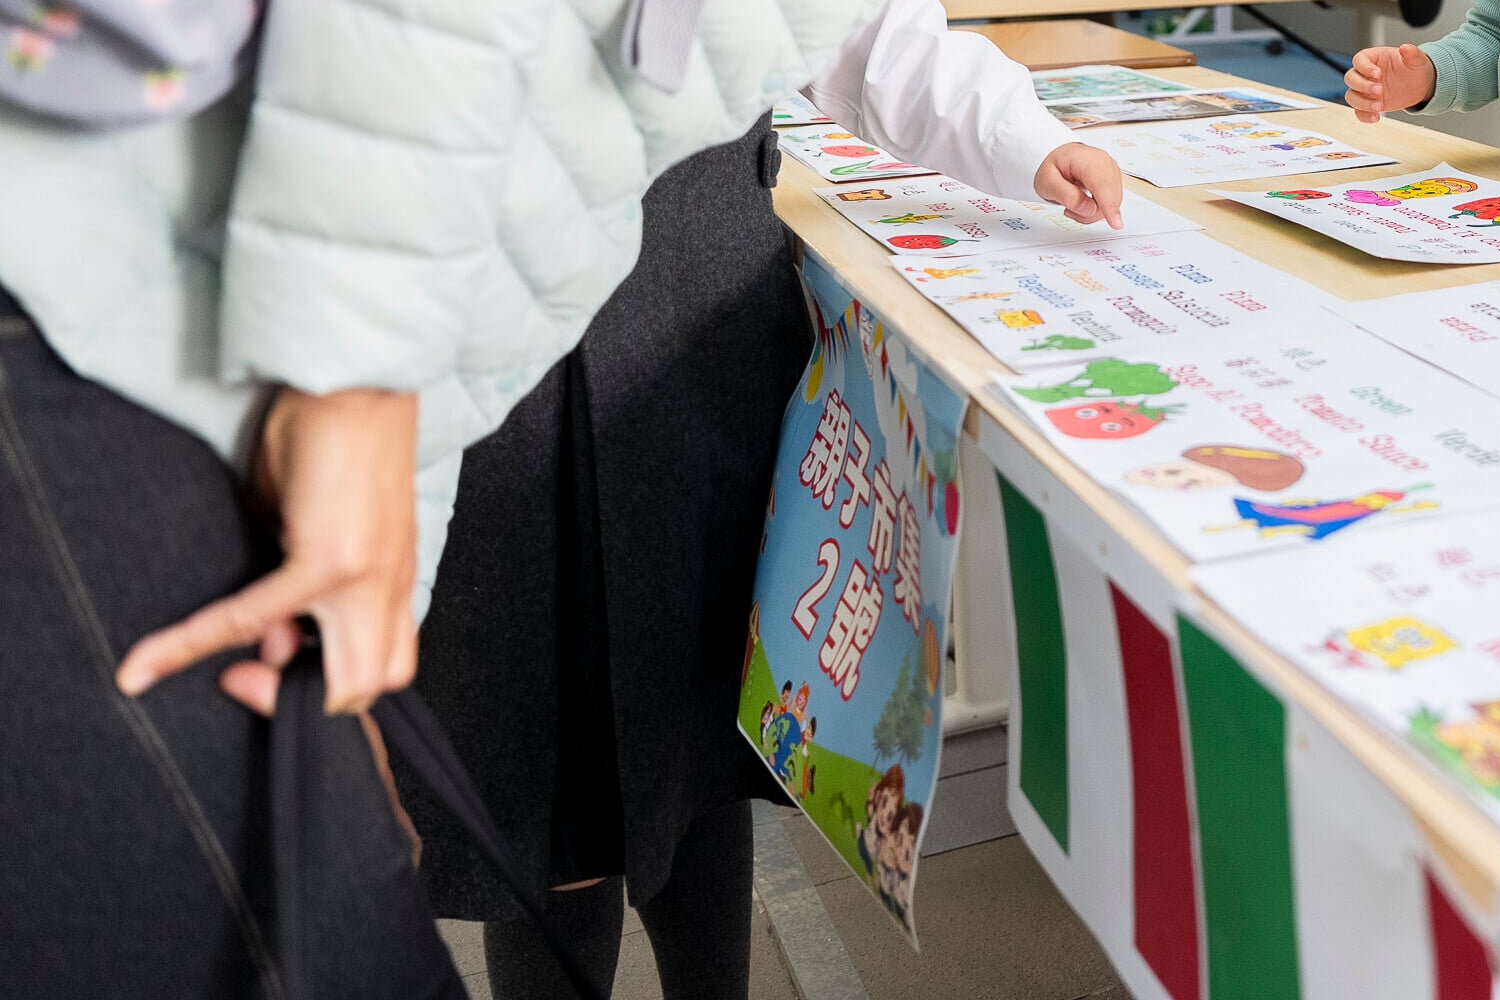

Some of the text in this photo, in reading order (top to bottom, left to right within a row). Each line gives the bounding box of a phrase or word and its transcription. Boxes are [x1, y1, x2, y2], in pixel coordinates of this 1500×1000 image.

[1015, 274, 1074, 308] Vegetable
[1067, 310, 1122, 343] Verdura
[1111, 264, 1164, 288] Sausage
[1157, 291, 1229, 327] Salsiccia
[1169, 264, 1212, 284] Pizza
[1219, 291, 1267, 312] Pizza
[1106, 296, 1176, 334] Formaggio
[1440, 317, 1498, 342] Pizza
[1167, 364, 1213, 389] Sugo
[1359, 435, 1428, 471] Sauce
[799, 388, 921, 635] 親子市集
[792, 538, 885, 702] 2號
